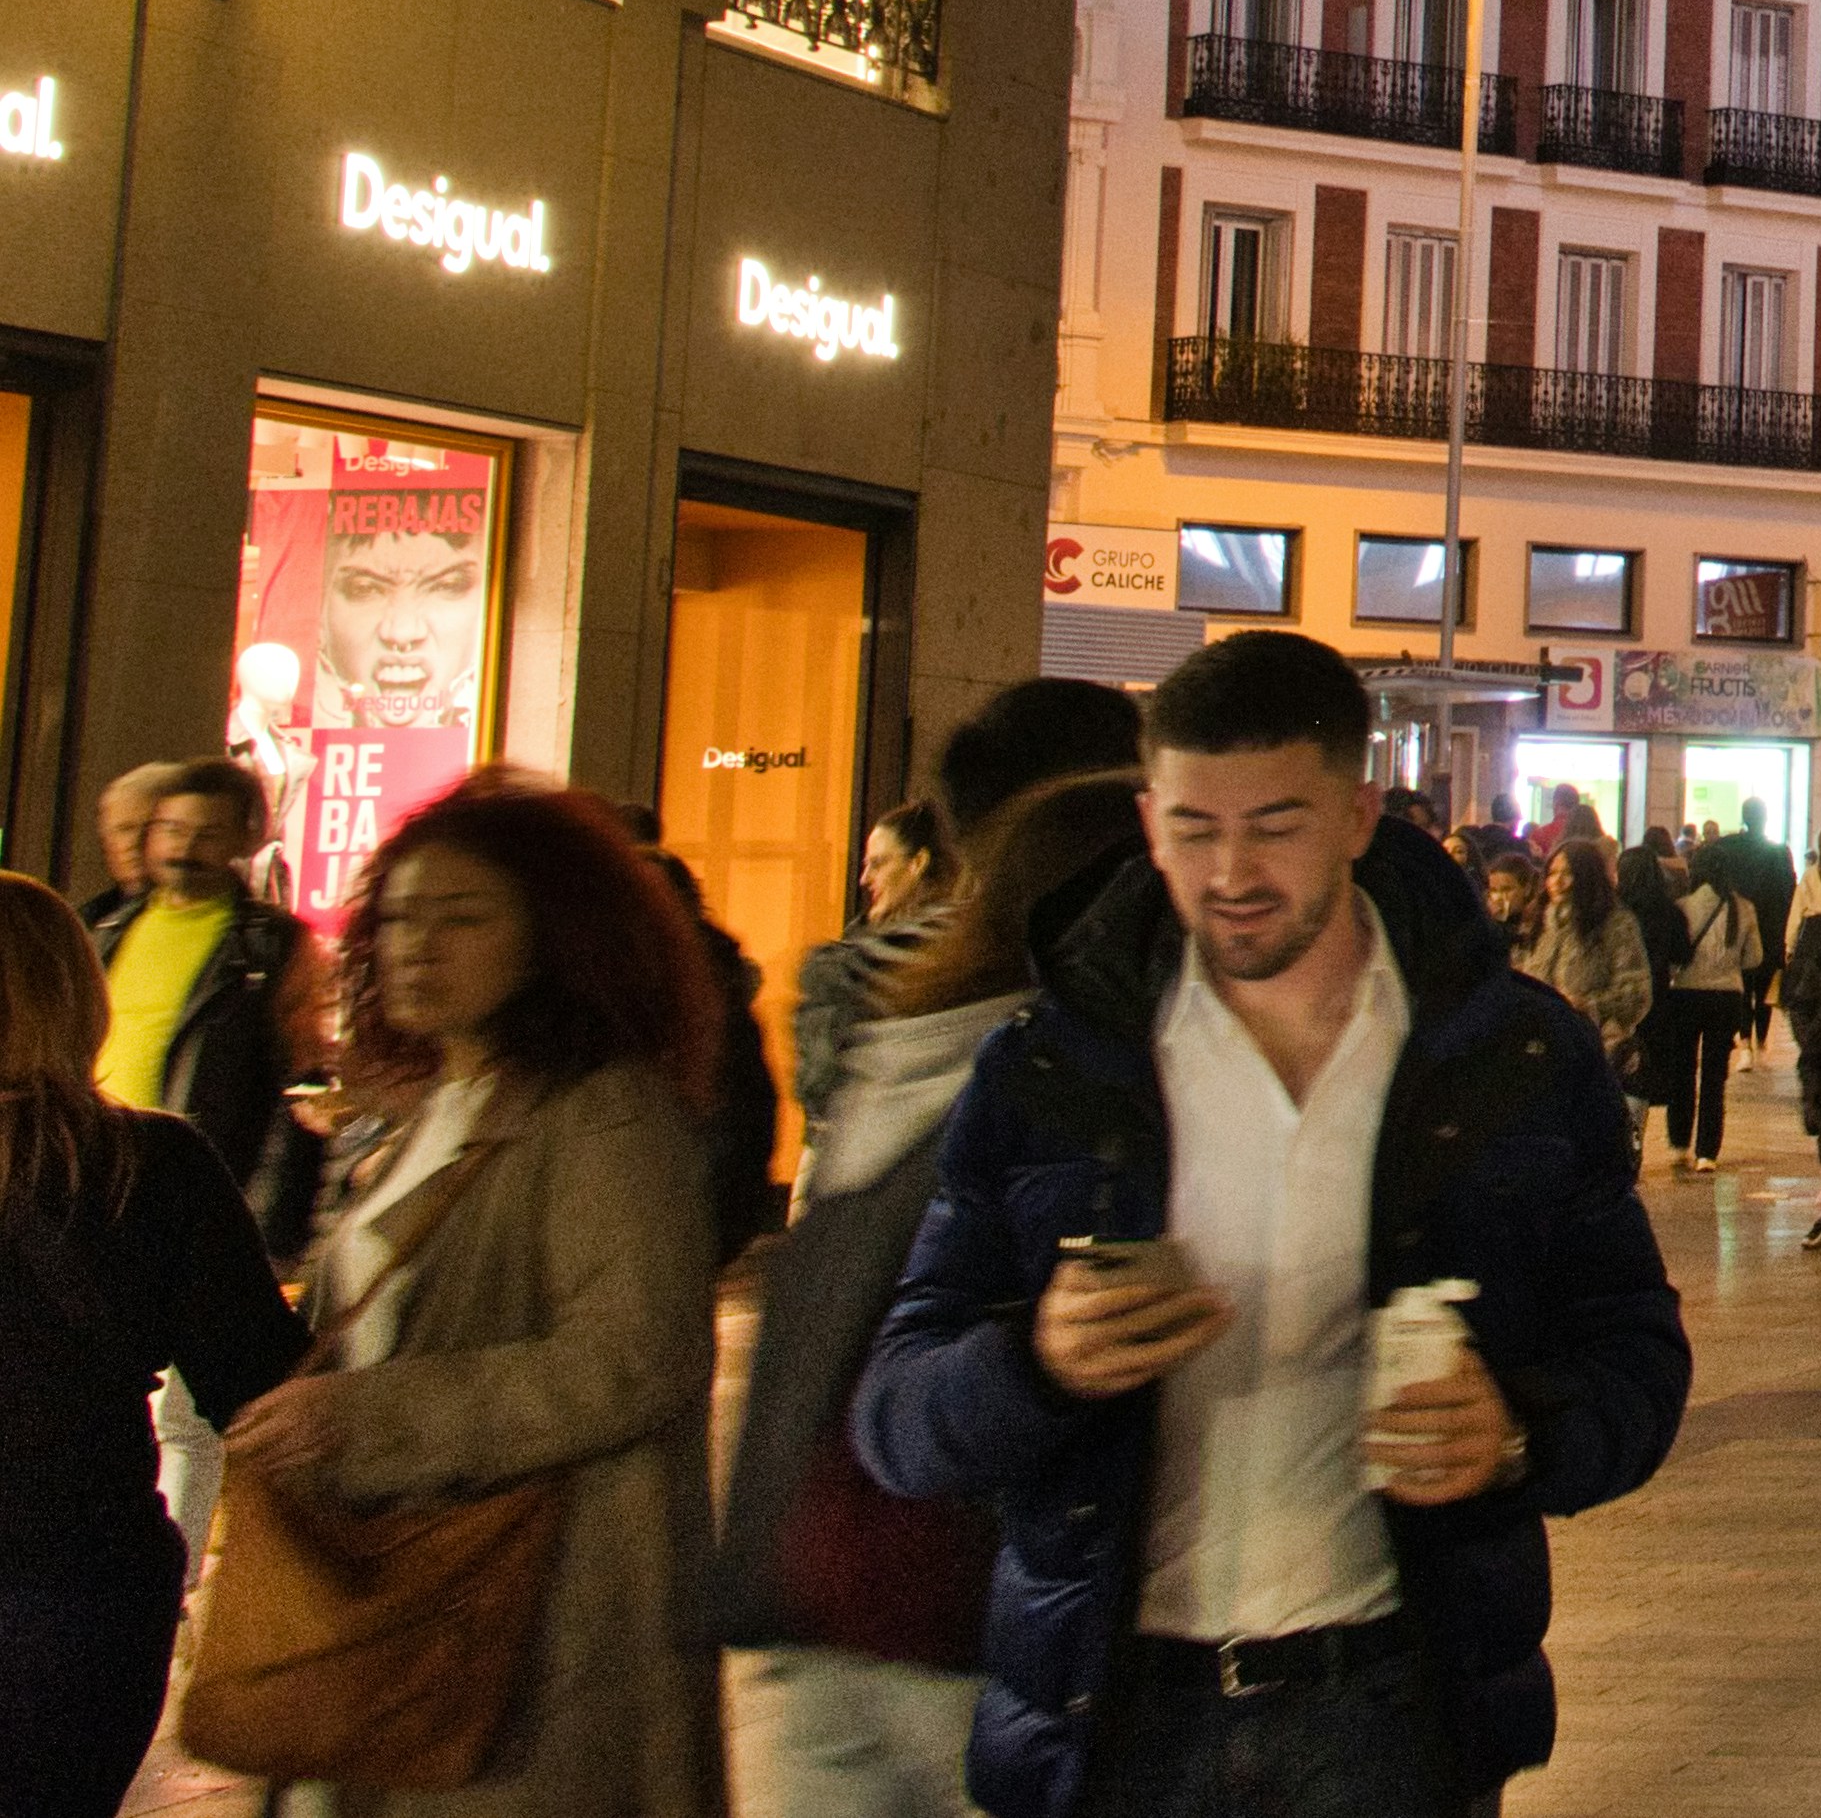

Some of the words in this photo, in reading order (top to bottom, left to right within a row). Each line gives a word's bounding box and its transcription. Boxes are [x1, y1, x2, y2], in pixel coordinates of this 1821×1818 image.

[339, 151, 552, 273] Desigual.
[737, 257, 899, 362] Desigual.
[333, 493, 482, 536] REBAJAS
[1092, 548, 1156, 570] GRUPO
[1091, 571, 1166, 591] CALICHE
[1690, 676, 1757, 698] FRUCTIS
[1694, 660, 1751, 675] GARNIER
[322, 742, 385, 798] RE
[317, 798, 379, 854] BA
